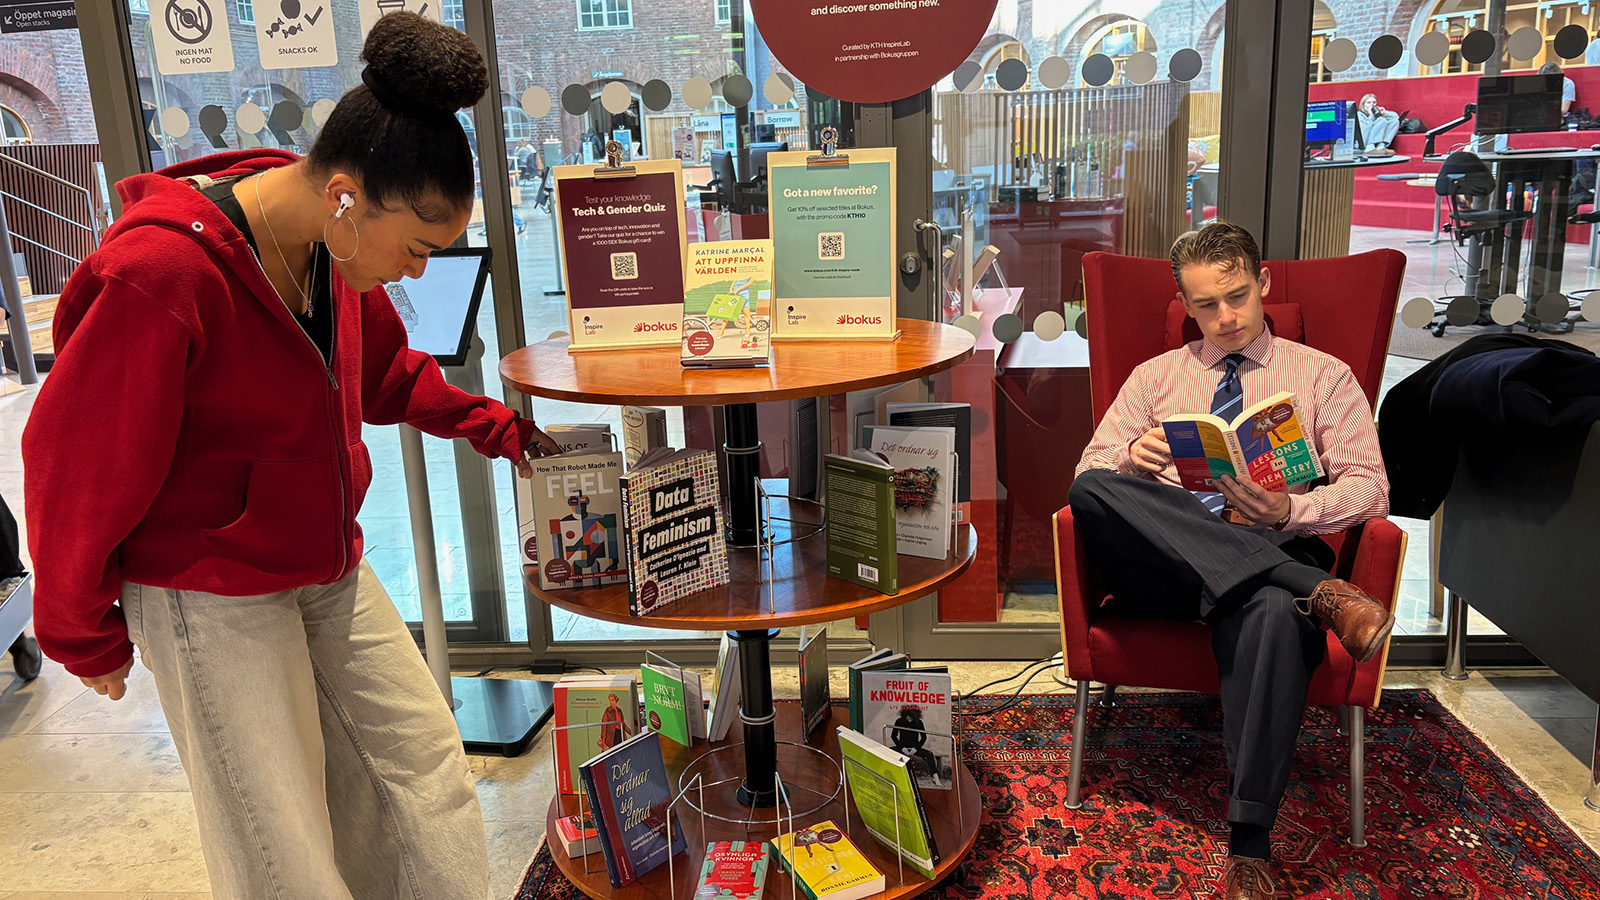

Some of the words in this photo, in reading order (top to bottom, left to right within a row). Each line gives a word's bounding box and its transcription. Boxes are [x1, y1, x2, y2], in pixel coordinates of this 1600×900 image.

[14, 9, 42, 21] Öppet
[811, 6, 828, 16] and
[830, 4, 867, 14] discover
[869, 0, 916, 10] something
[840, 54, 869, 62] partnership
[694, 119, 709, 127] Låna
[784, 188, 802, 197] Got
[833, 185, 878, 196] favorite?
[585, 196, 599, 204] Test
[572, 207, 596, 216] Tech
[597, 206, 605, 215] &
[606, 205, 642, 214] Gender
[644, 203, 666, 212] Quiz
[715, 256, 764, 264] UPPFINNA
[695, 266, 736, 275] VÄRLDEN
[847, 314, 881, 324] bokus
[644, 322, 677, 332] bokus
[881, 442, 896, 452] Det
[898, 444, 926, 455] ordnar
[927, 448, 938, 459] sig
[1253, 442, 1298, 469] LESSONS
[1258, 461, 1310, 486] HEMISTRY
[1286, 473, 1316, 484] GARMUS
[546, 472, 613, 498] FEEL
[655, 487, 689, 512] Data
[643, 516, 710, 554] Feminism
[650, 557, 672, 571] Catherine
[697, 545, 706, 554] and
[660, 568, 677, 578] Lauren
[684, 559, 697, 569] Klein
[654, 683, 675, 697] BRYT
[886, 680, 914, 690] FRUIT
[918, 682, 929, 691] OF
[653, 695, 682, 710] NORM!
[871, 690, 945, 704] KNOWLEDGE
[612, 758, 632, 781] Det
[616, 769, 650, 798] ordnar
[620, 797, 633, 817] sig
[625, 800, 651, 832] alltid
[797, 849, 855, 871] LEKTIONER
[821, 882, 845, 892] BONNIE
[846, 873, 873, 884] GARMUS
[829, 871, 856, 883] KEMI
